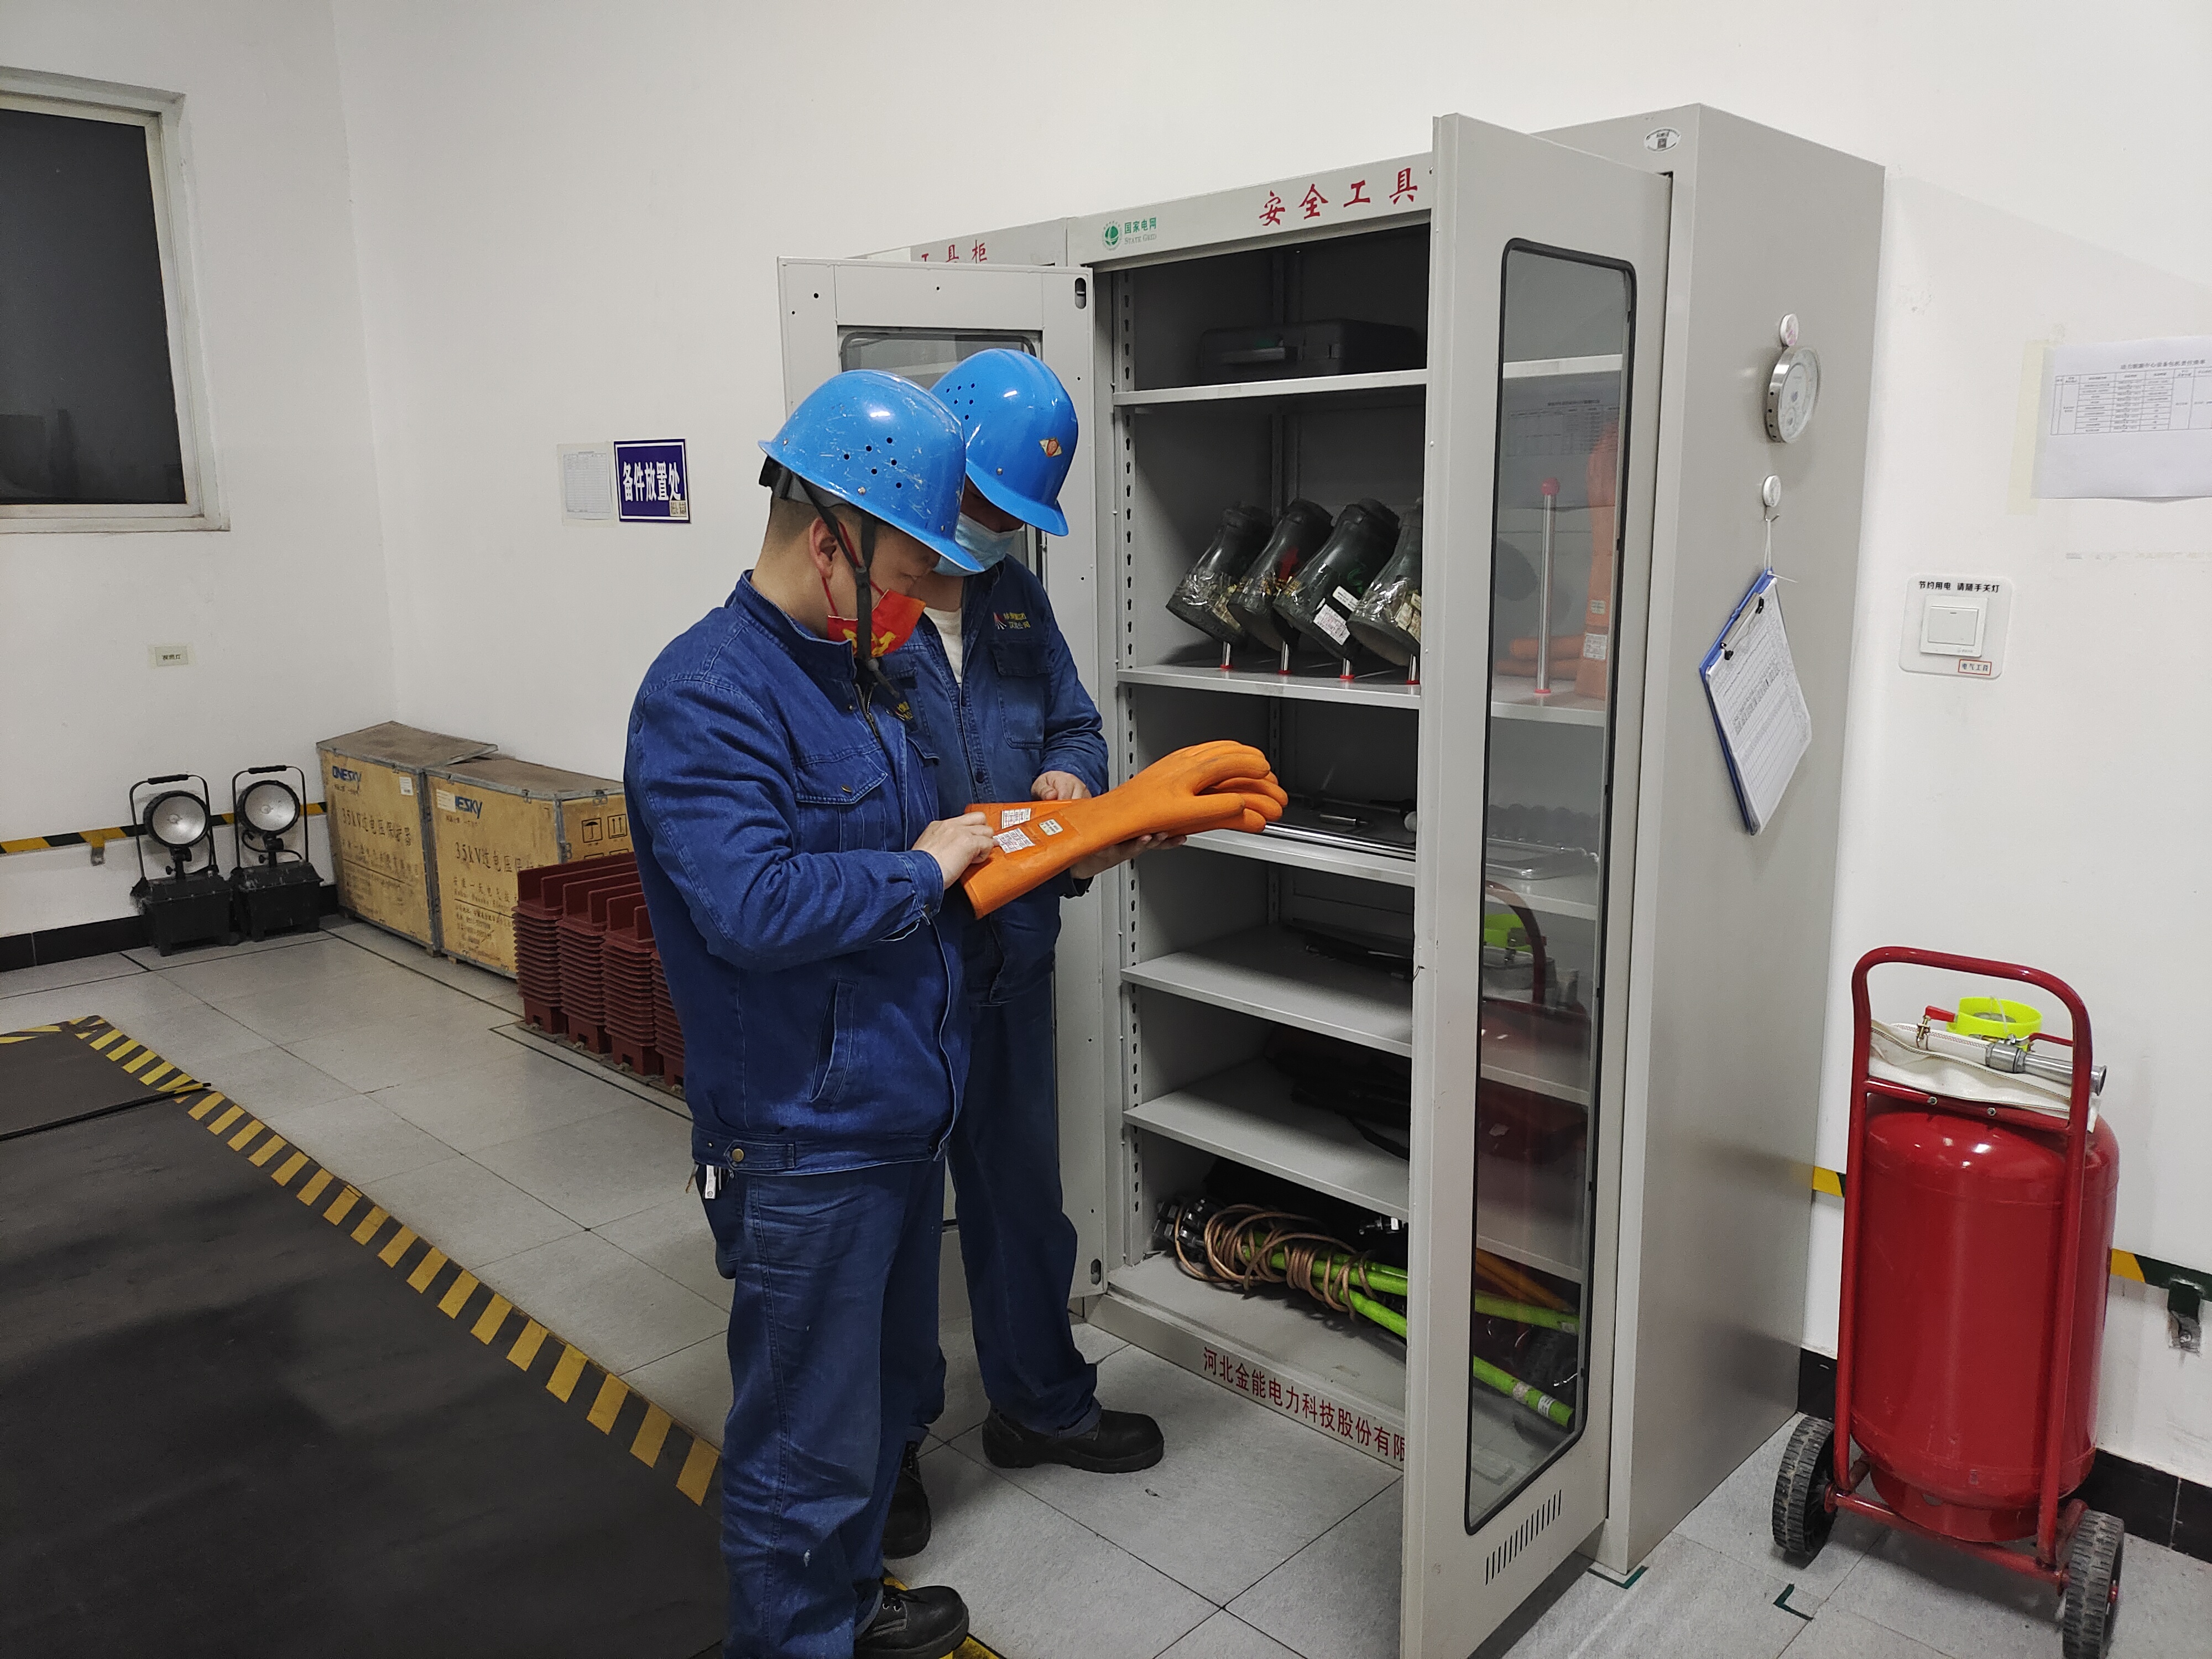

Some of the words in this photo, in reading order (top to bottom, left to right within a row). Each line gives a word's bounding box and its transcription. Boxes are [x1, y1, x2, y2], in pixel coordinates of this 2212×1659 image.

[1259, 168, 1418, 227] 安全工具
[1124, 217, 1156, 234] 国家电网
[623, 461, 681, 502] 备件放置处
[1919, 581, 1951, 591] 节约用电
[1957, 582, 2000, 593] 请随手关灯
[1203, 1347, 1405, 1462] 河北金能电力科技股份有限
